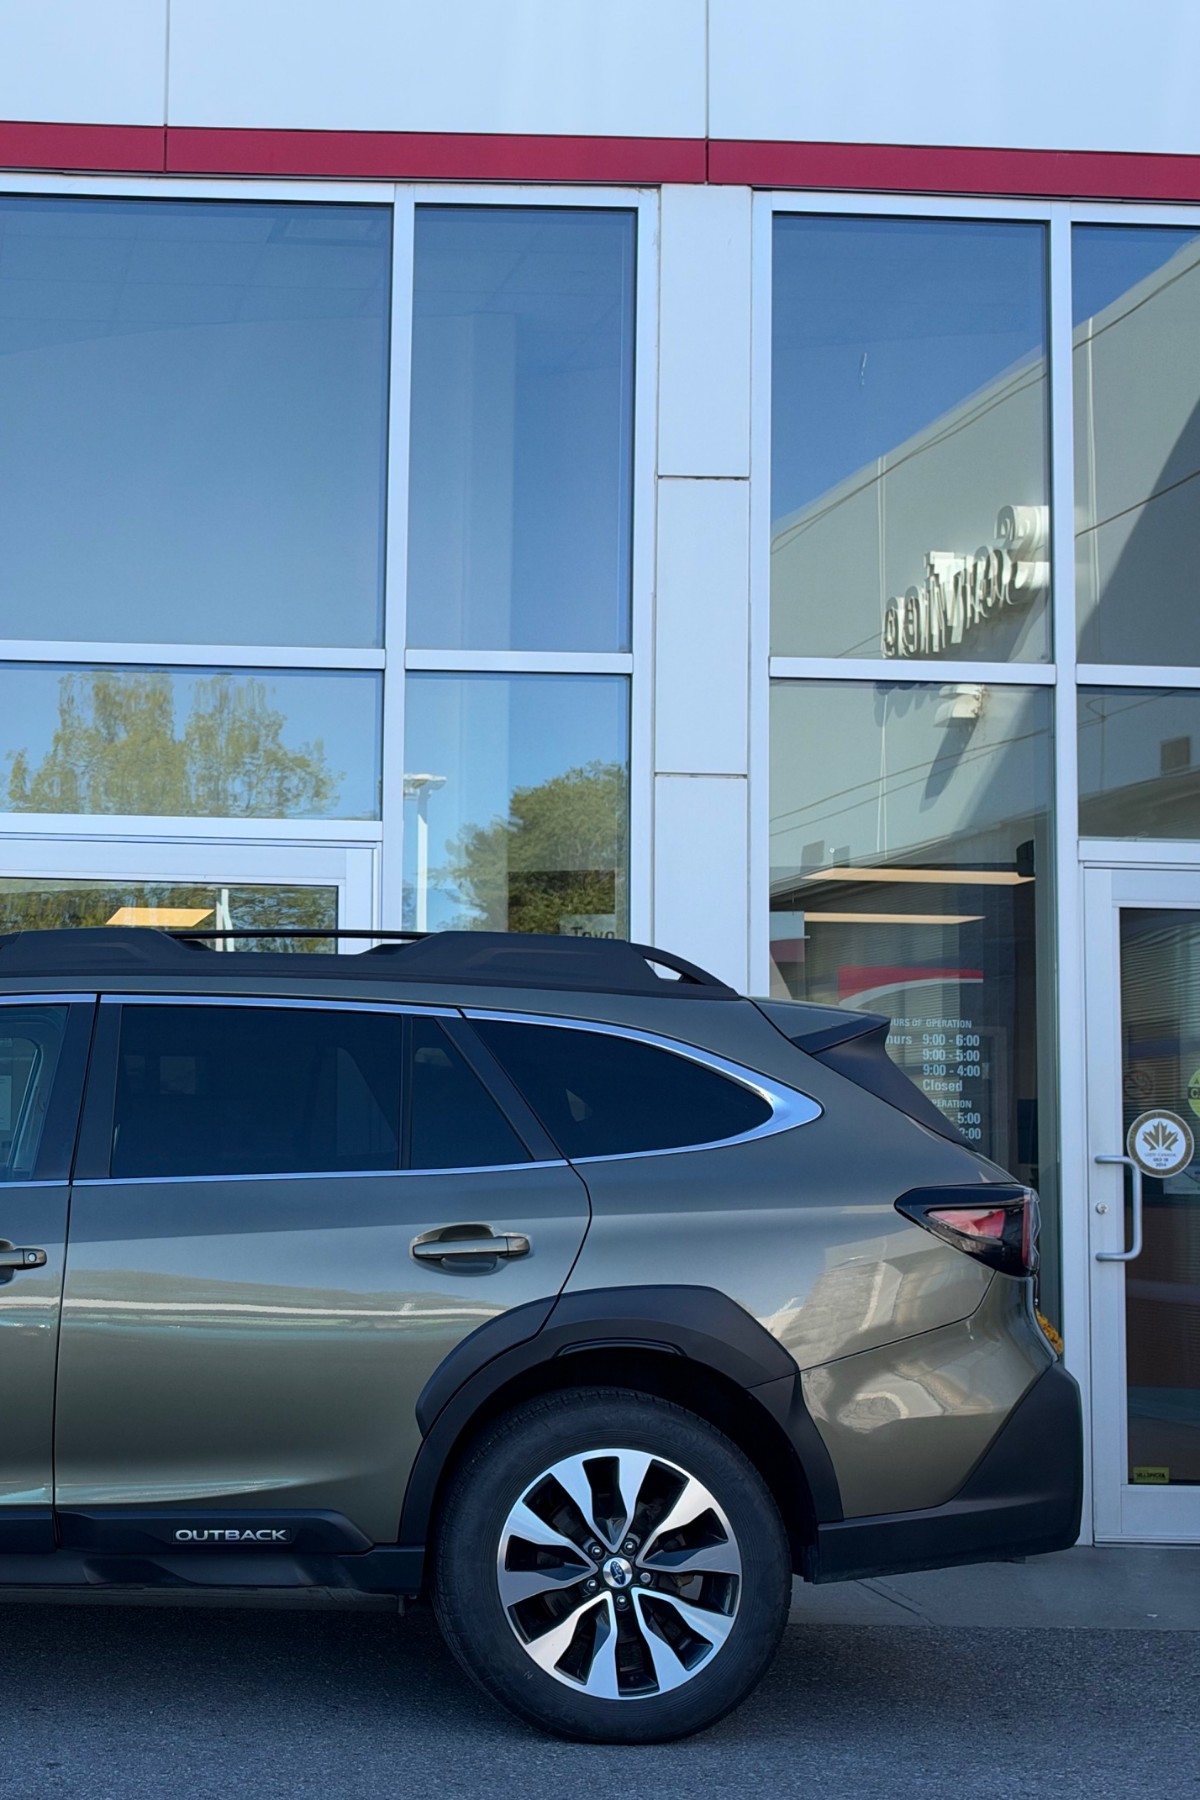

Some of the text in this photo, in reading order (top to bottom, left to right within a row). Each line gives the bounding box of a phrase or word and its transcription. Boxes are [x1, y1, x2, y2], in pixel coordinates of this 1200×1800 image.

[926, 1019, 972, 1029] OPERATION
[886, 1034, 912, 1045] hurs
[922, 1033, 946, 1046] 9:00
[956, 1034, 980, 1046] 6:00
[922, 1049, 946, 1061] 9:00
[956, 1049, 980, 1062] 5:00
[922, 1064, 946, 1076] 9:00
[957, 1065, 980, 1077] 4:00
[922, 1079, 963, 1092] Closed
[931, 1099, 972, 1109] PERATION
[957, 1112, 981, 1124] 5:00
[175, 1529, 287, 1541] OUTBACK
